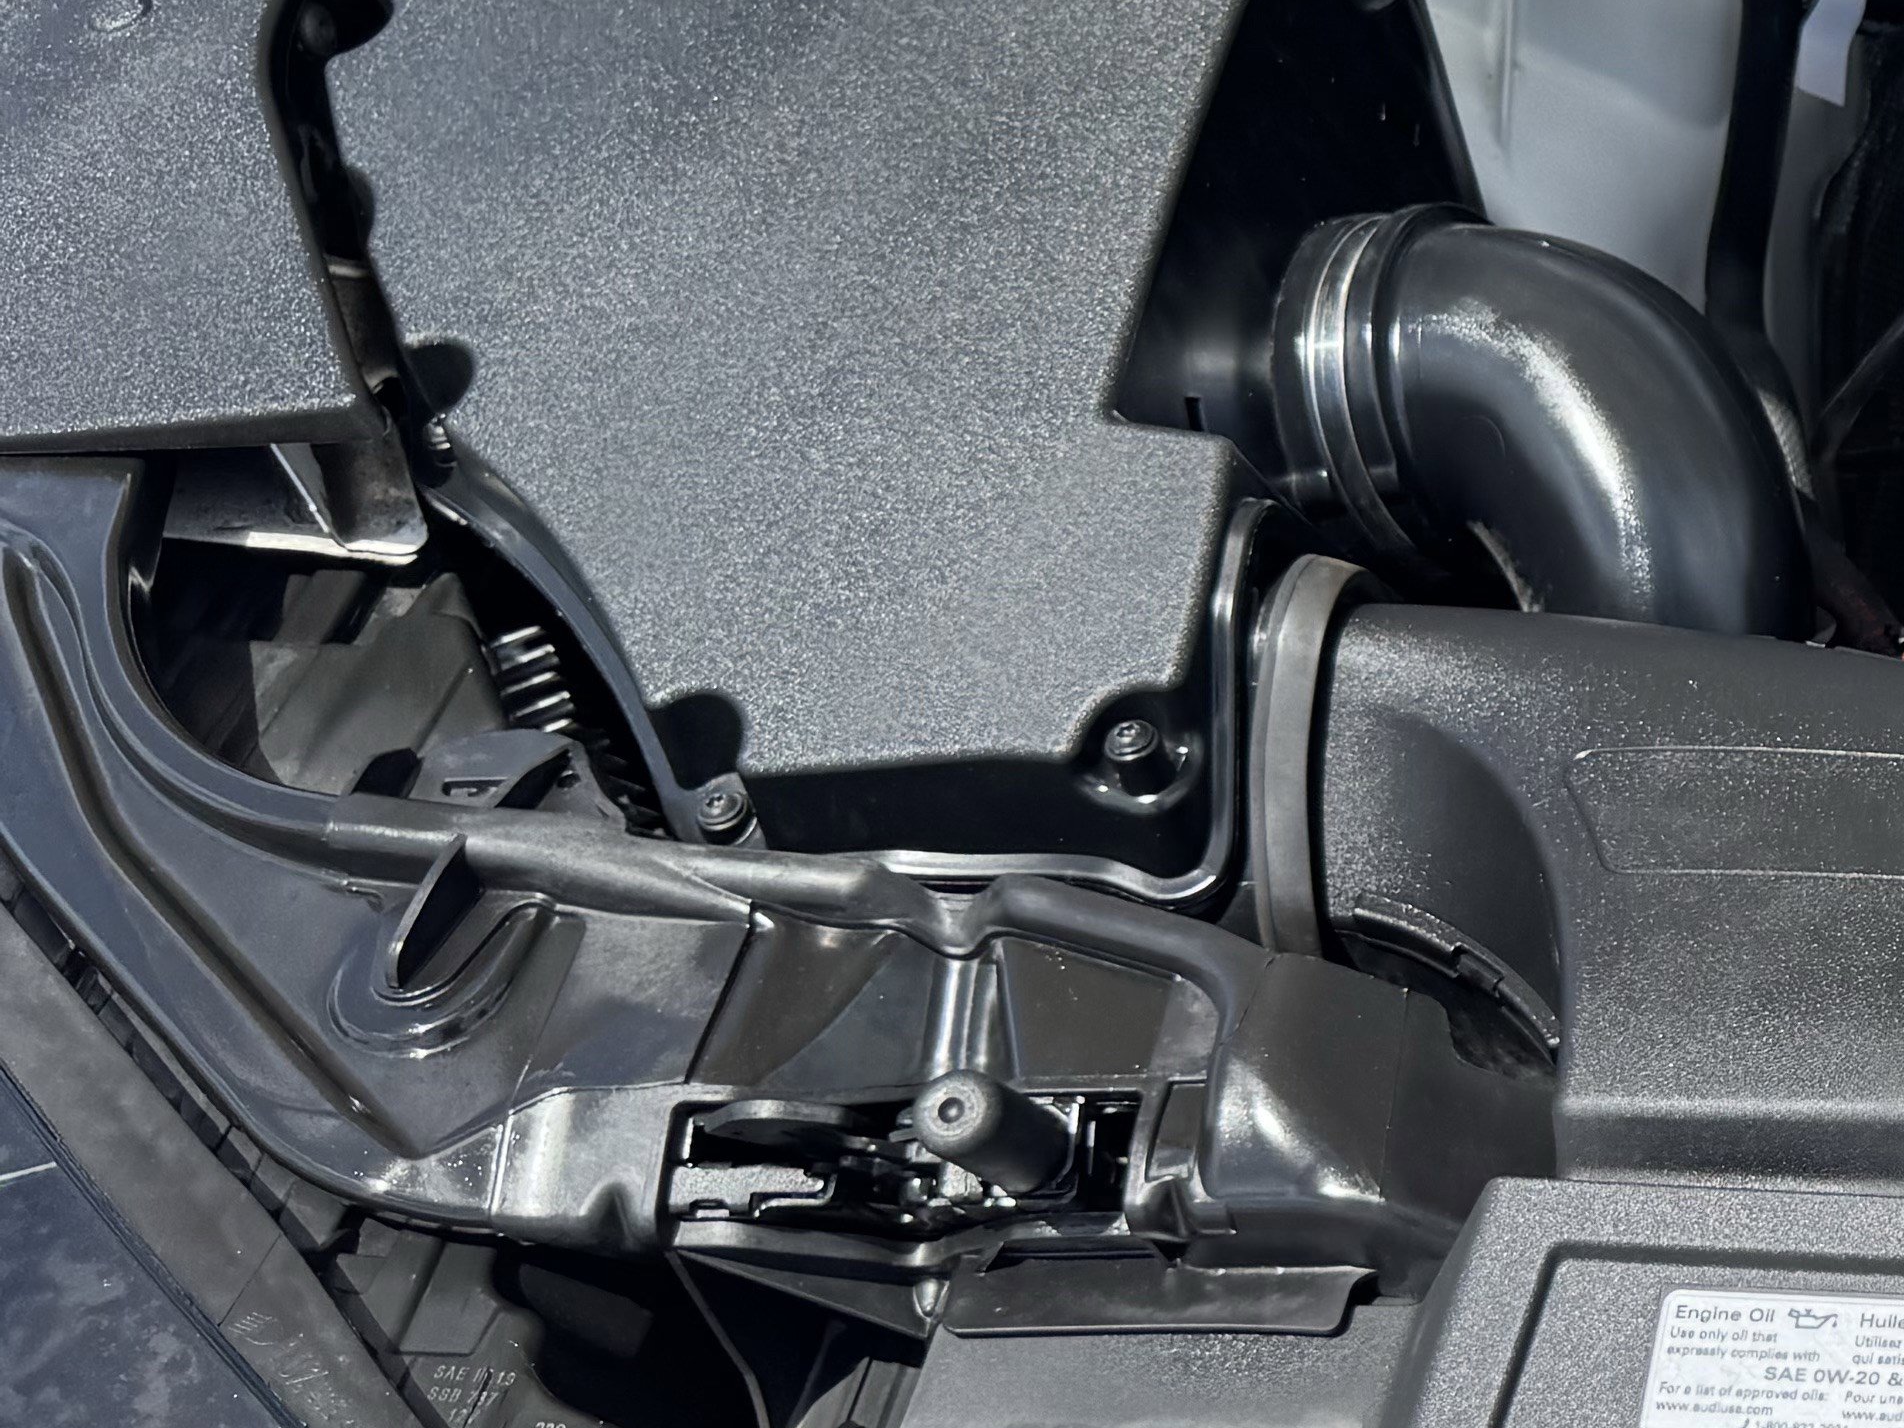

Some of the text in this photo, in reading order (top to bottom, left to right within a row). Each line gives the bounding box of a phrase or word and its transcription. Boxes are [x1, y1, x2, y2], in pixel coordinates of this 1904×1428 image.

[1675, 1304, 1775, 1323] Engine Oil
[1670, 1326, 1777, 1343] Use only oil that
[1854, 1335, 1902, 1349] Utilisez
[1666, 1345, 1820, 1362] expressly complies with
[1852, 1353, 1874, 1367] qui
[433, 1364, 470, 1381] SAE
[1763, 1366, 1808, 1383] SAE
[1813, 1369, 1880, 1386] 0W-20
[1887, 1372, 1904, 1387] &
[1659, 1381, 1681, 1395] For
[1684, 1385, 1691, 1395] a
[1695, 1383, 1715, 1396] list
[1718, 1384, 1733, 1397] of
[1735, 1386, 1798, 1401] approved
[1845, 1390, 1875, 1404] Pour
[1879, 1394, 1903, 1405] une
[1656, 1401, 1773, 1416] www.audiusa.com
